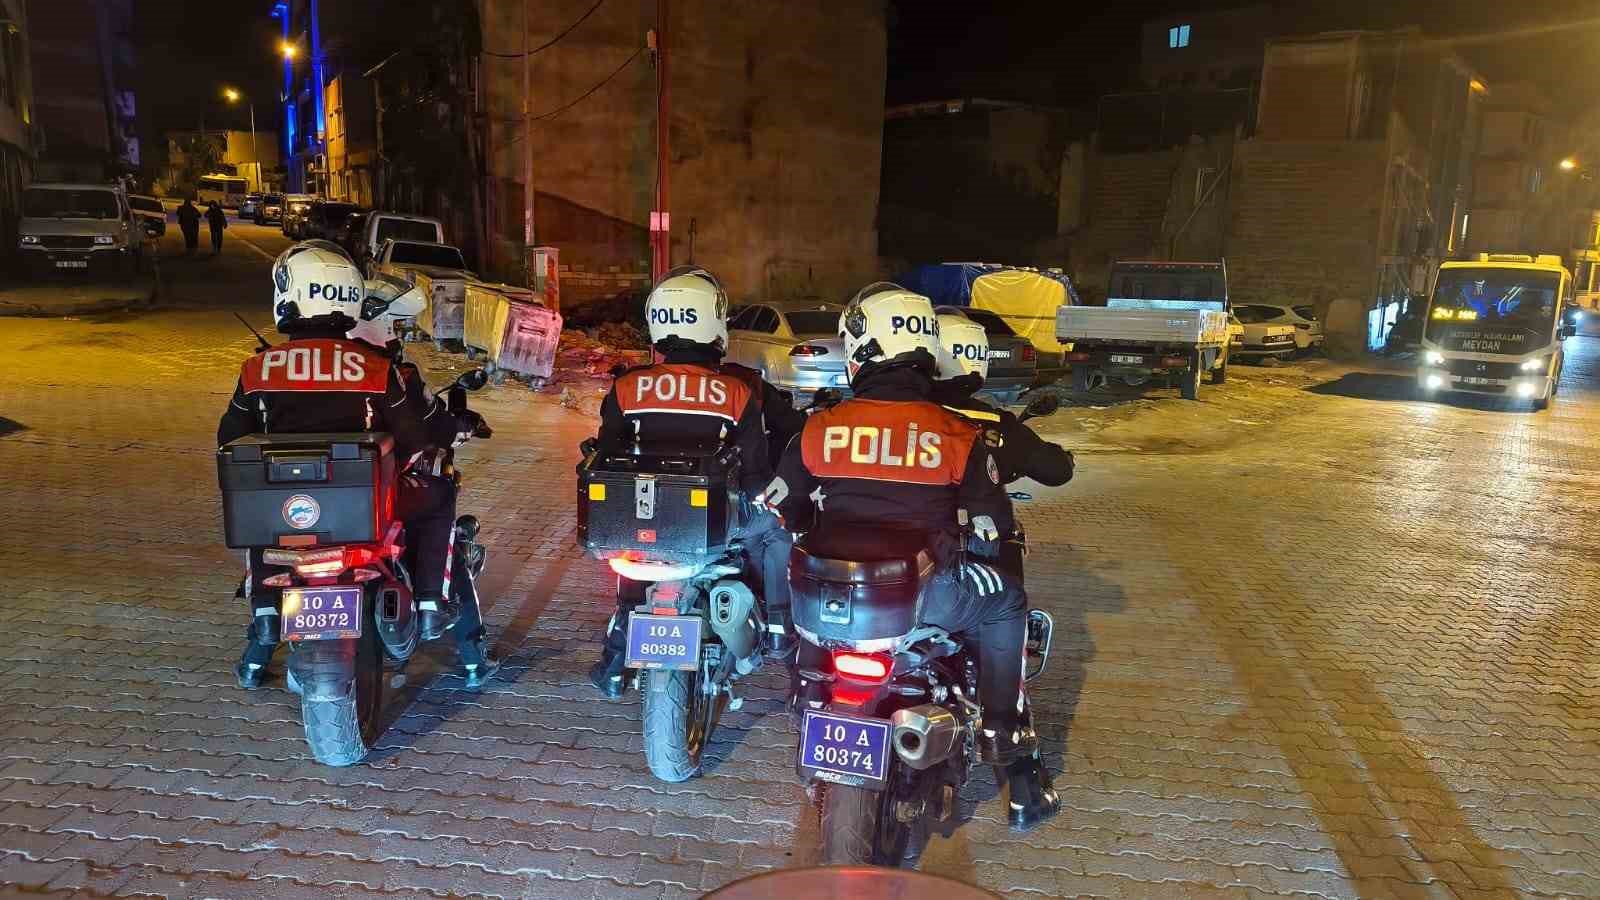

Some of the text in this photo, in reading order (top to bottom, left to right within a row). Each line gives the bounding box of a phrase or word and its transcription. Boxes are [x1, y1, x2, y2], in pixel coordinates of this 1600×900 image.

[302, 595, 345, 610] 10 A
[294, 612, 349, 628] 80372
[649, 625, 682, 638] 10 A
[640, 642, 686, 656] 80382
[823, 723, 870, 747] 10 A
[813, 744, 873, 770] 80374
